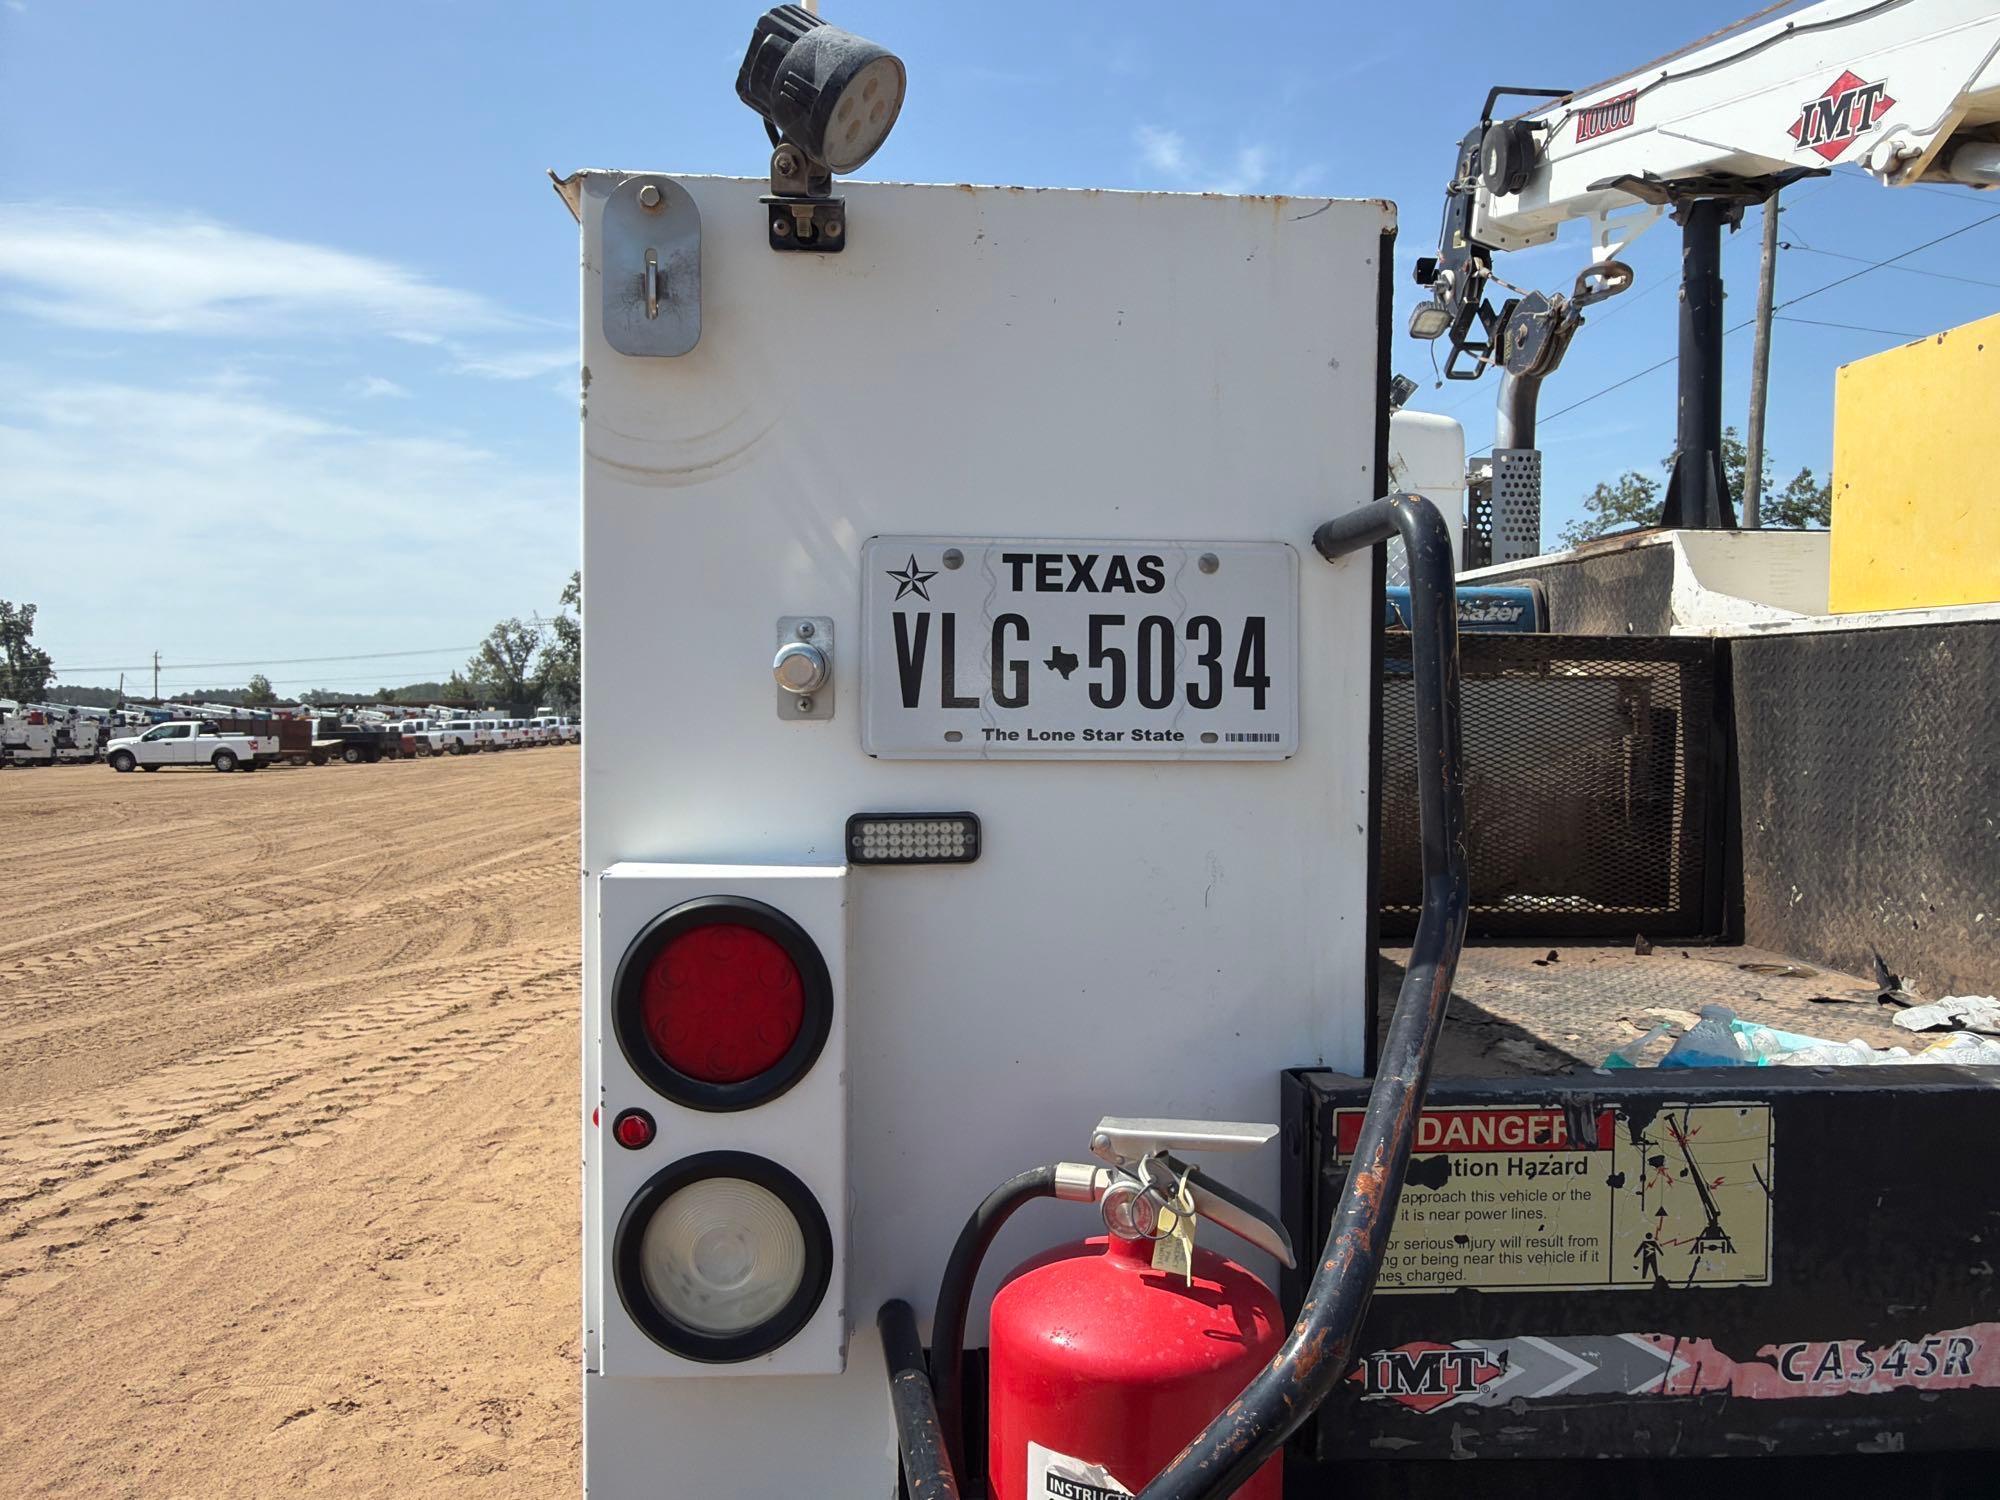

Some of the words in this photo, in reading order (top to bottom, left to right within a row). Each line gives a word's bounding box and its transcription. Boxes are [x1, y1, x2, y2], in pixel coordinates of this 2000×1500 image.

[1579, 95, 1633, 140] 10000
[1795, 78, 1887, 151] IMT
[1002, 553, 1166, 594] TEXAS
[892, 612, 1030, 709] VLG
[1088, 614, 1271, 711] 5034
[981, 728, 1023, 742] The
[1027, 728, 1078, 742] Lone
[1082, 728, 1127, 742] Star
[1130, 729, 1185, 742] State
[1507, 1156, 1588, 1178] Hazard
[1401, 1191, 1466, 1206] approach
[1471, 1190, 1495, 1203] this
[1500, 1189, 1548, 1202] vehicle
[1552, 1192, 1567, 1202] or
[1570, 1189, 1592, 1201] the
[1401, 1209, 1410, 1222] it
[1413, 1209, 1425, 1221] is
[1429, 1211, 1460, 1221] near
[1464, 1210, 1508, 1223] power
[1511, 1208, 1547, 1220] lines.
[1386, 1240, 1399, 1250] or
[1403, 1237, 1454, 1250] serious
[1499, 1235, 1522, 1249] will
[1526, 1235, 1564, 1248] result
[1568, 1234, 1599, 1248] from
[1402, 1256, 1417, 1266] or
[1421, 1252, 1459, 1268] being
[1463, 1253, 1495, 1265] near
[1499, 1251, 1523, 1265] this
[1527, 1250, 1576, 1264] vehicle
[1579, 1249, 1589, 1263] if
[1591, 1249, 1600, 1263] it
[1406, 1268, 1467, 1284] charged.
[1363, 1349, 1488, 1396] IMT
